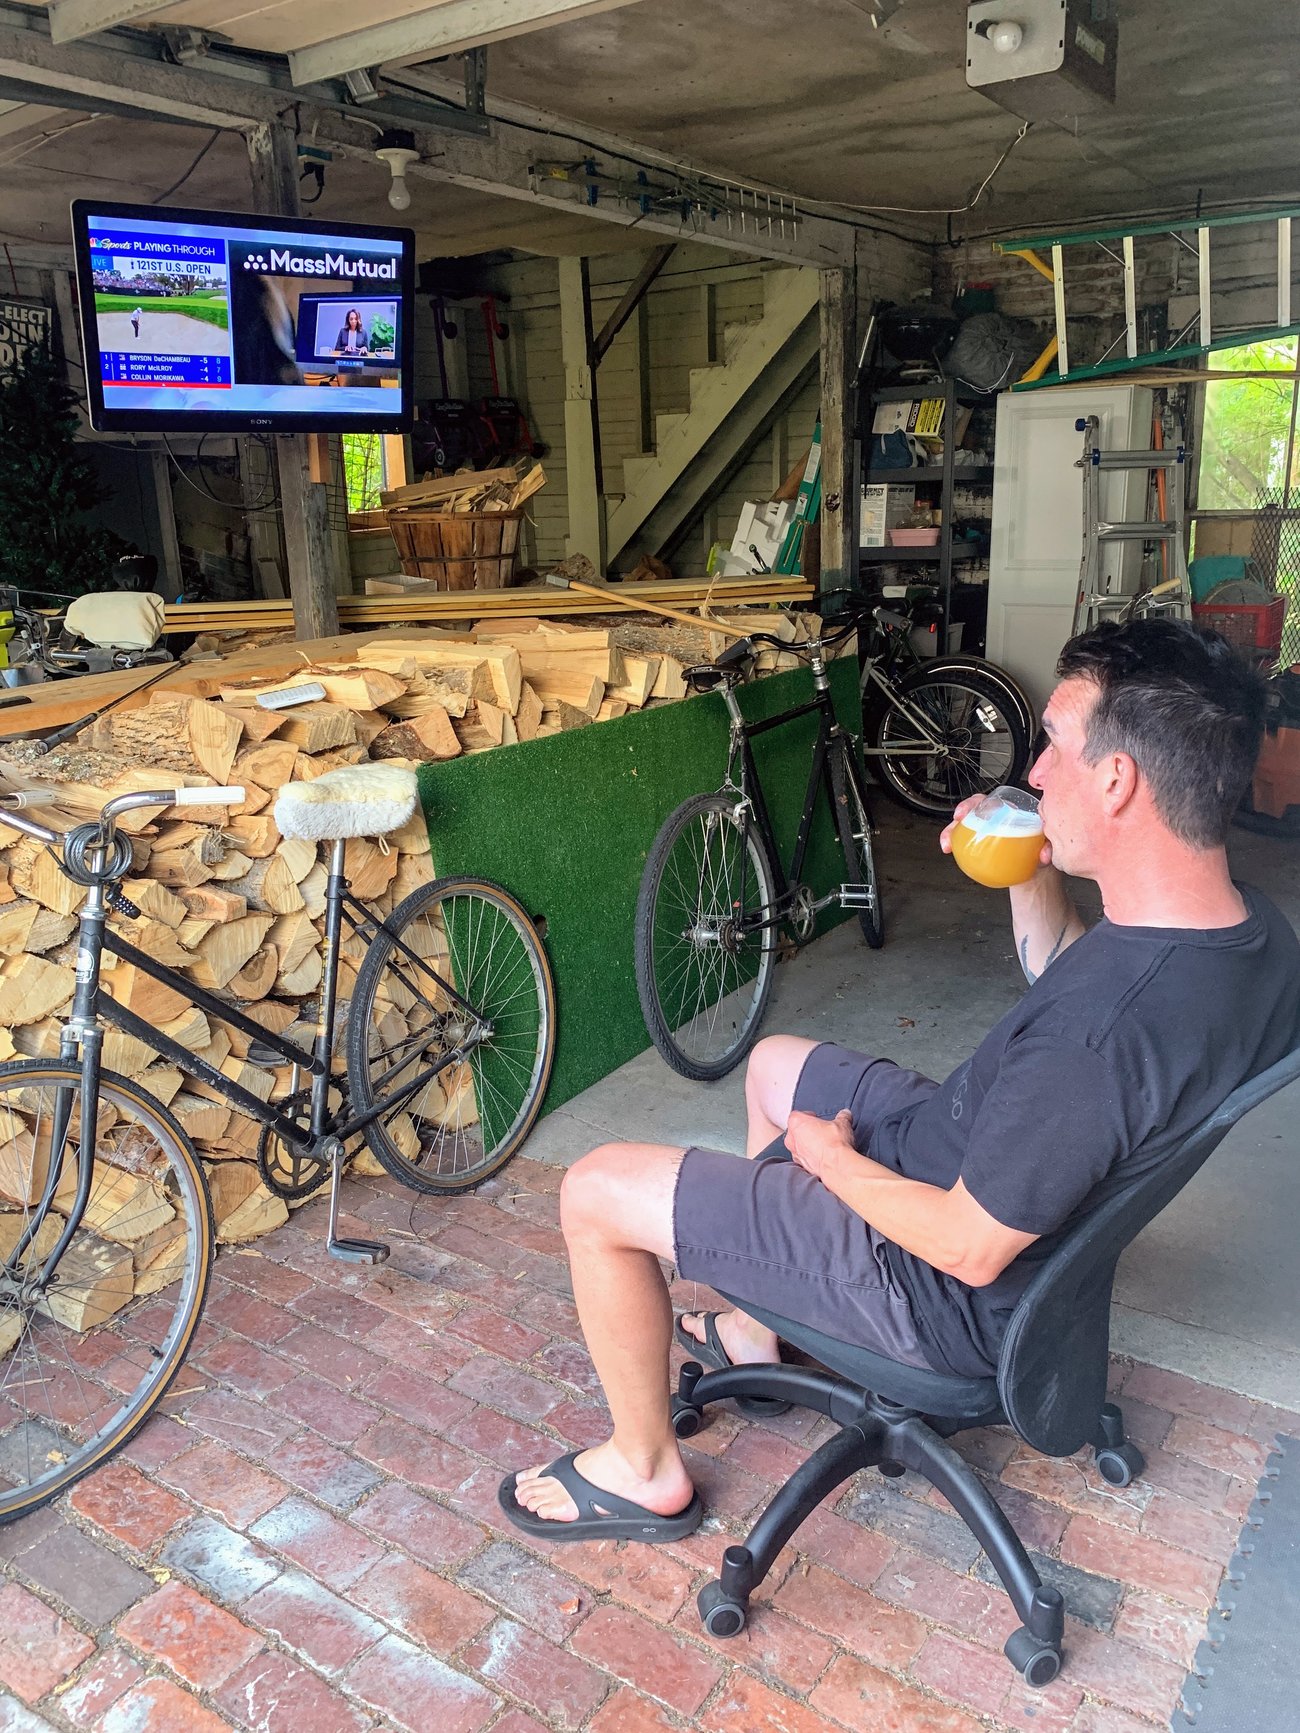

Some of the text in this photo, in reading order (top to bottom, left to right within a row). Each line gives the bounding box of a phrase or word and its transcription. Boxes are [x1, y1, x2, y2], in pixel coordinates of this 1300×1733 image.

[133, 241, 172, 253] PLAYING
[172, 244, 216, 256] THROUGH
[91, 258, 107, 267] IVE
[136, 260, 211, 275] 121ST U.S. OPEN
[270, 248, 396, 279] MassMutual
[129, 354, 152, 362] BRYSON
[131, 373, 152, 381] COLLIN
